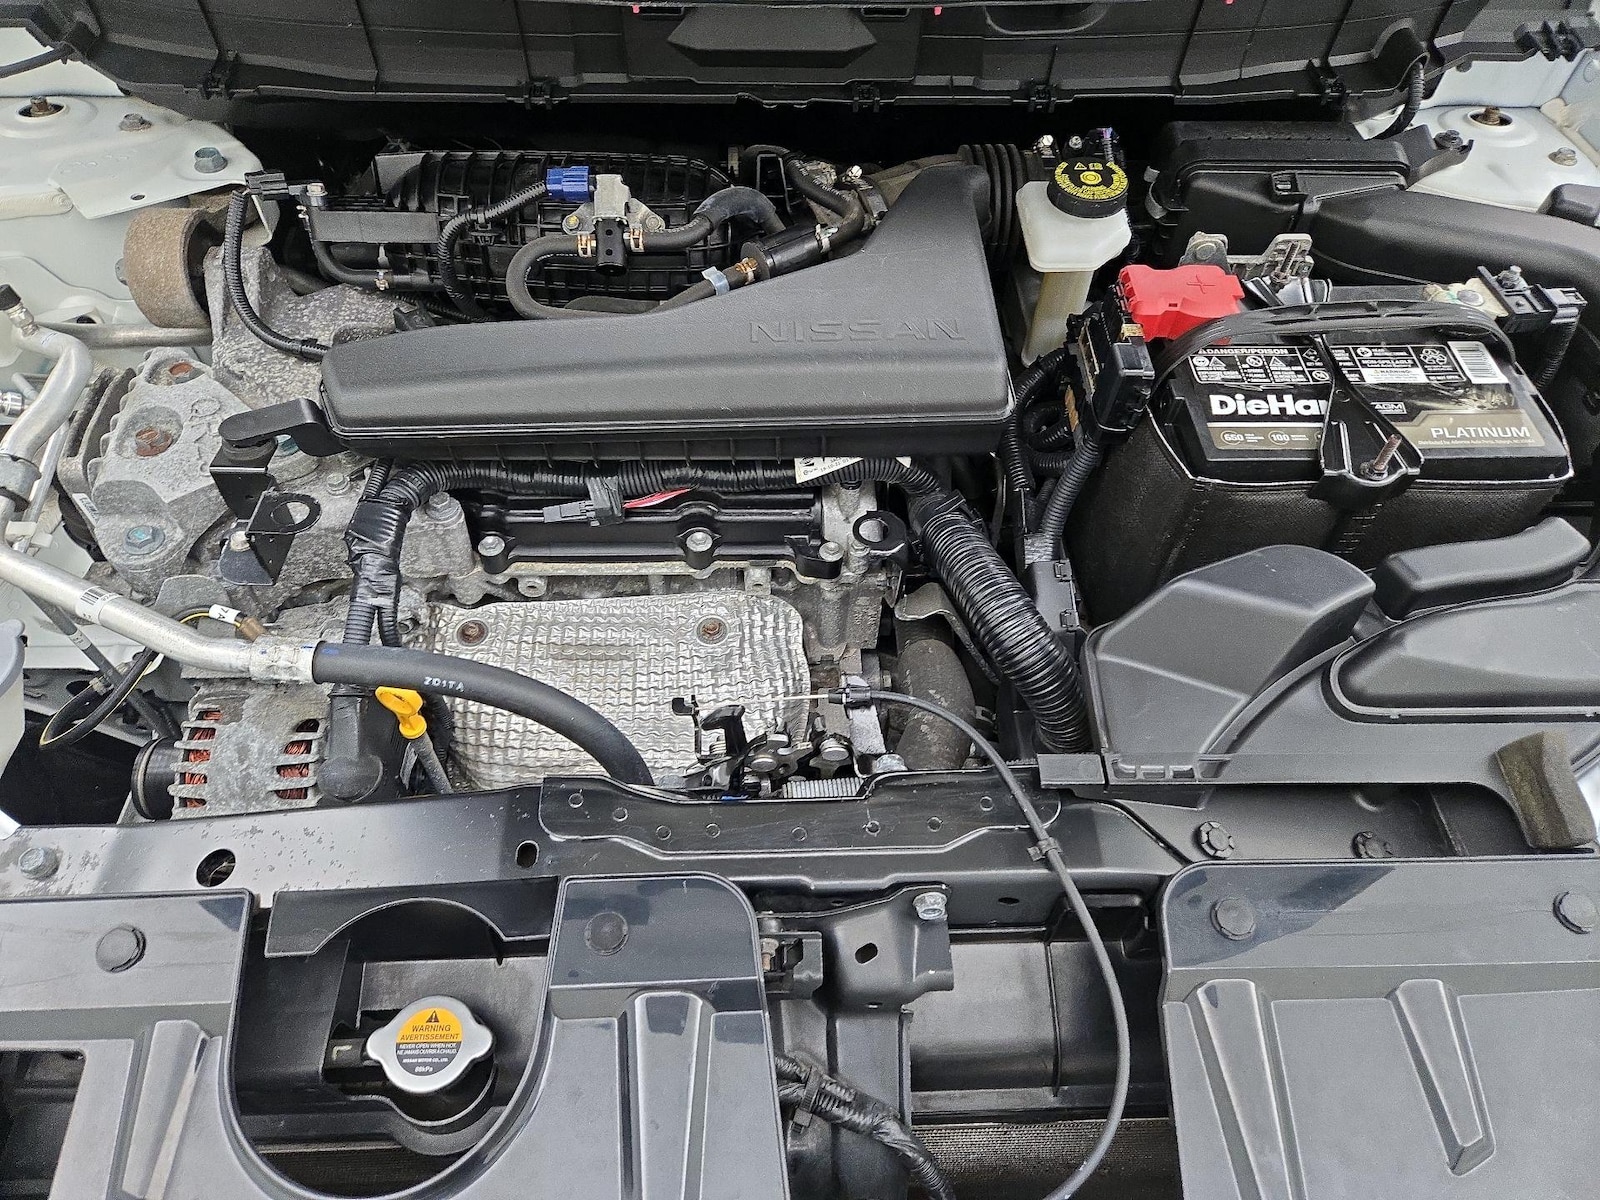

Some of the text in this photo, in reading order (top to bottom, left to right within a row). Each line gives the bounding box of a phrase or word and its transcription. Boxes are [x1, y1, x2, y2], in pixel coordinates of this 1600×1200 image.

[750, 318, 967, 343] NISSAN
[1209, 393, 1328, 416] DieHar
[1430, 426, 1531, 439] PLATINUM
[411, 1024, 451, 1032] WARNING
[400, 1033, 460, 1041] AVERTISSEMENT
